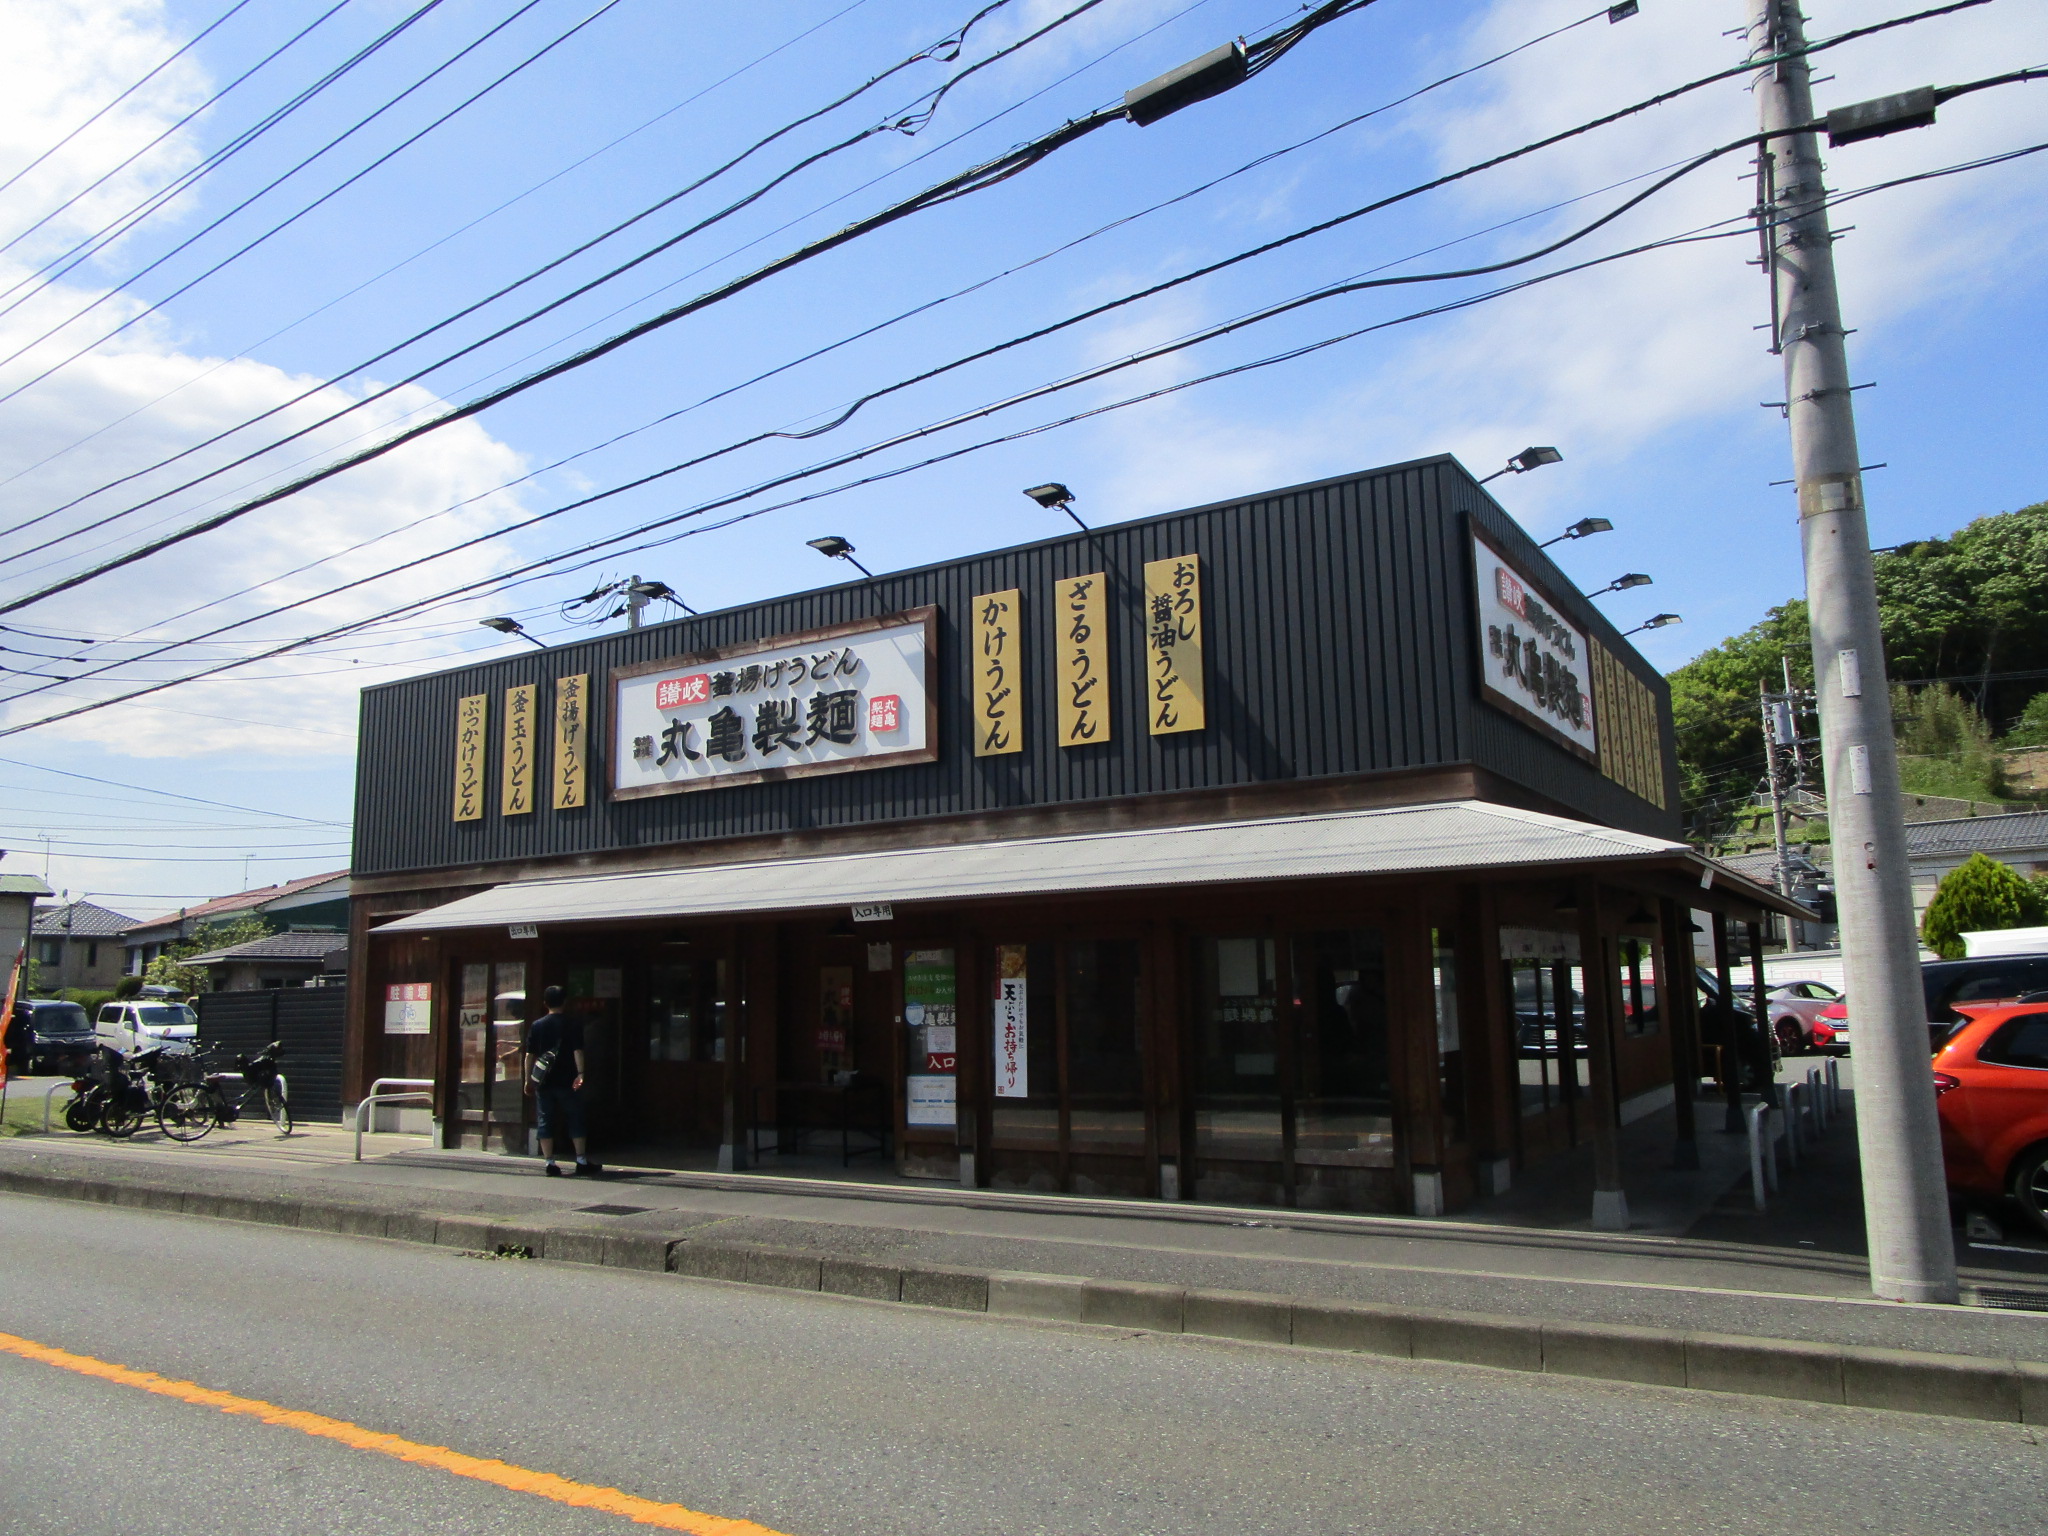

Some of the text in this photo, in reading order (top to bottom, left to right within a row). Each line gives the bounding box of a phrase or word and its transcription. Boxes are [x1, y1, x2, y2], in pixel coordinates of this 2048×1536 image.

[1173, 562, 1196, 641] おろし
[710, 646, 862, 700] 釜揚げうどん
[982, 598, 1010, 751] かけうどん
[1069, 580, 1097, 741] ざるうどん
[1151, 594, 1178, 728] 醤油うどん
[459, 699, 483, 818] ぶっかけうどん
[508, 689, 530, 812] 釜玉うどん
[559, 677, 582, 808] 釜揚げうどん
[655, 689, 859, 767] 丸亀製麺
[855, 904, 892, 918] 入口専用
[461, 1012, 480, 1026] 入口
[928, 1055, 956, 1069] 入口
[1003, 983, 1018, 1088] 天ぷらお持ち帰り
